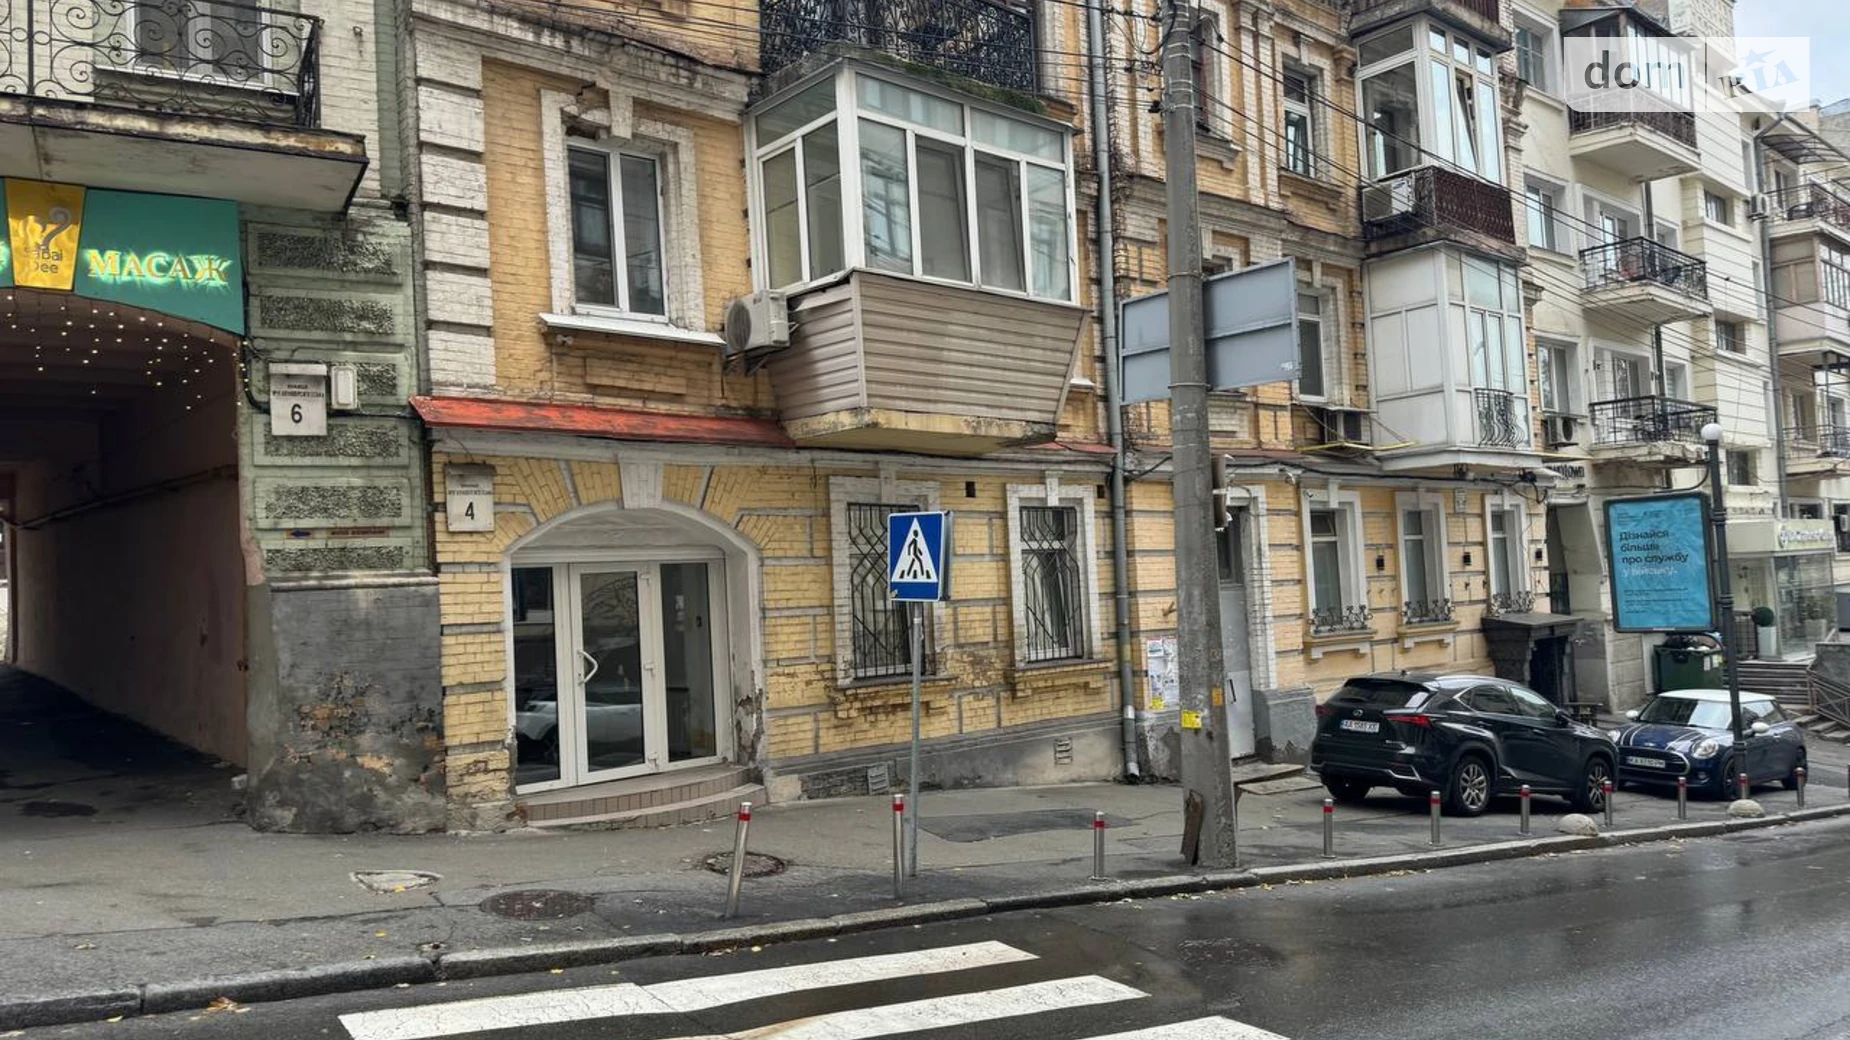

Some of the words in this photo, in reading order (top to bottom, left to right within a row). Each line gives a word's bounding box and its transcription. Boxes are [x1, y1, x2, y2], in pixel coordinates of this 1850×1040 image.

[87, 250, 231, 284] МАСАЖ
[291, 403, 303, 424] 6
[465, 501, 475, 520] 4
[1621, 556, 1643, 566] про
[1644, 552, 1689, 565] службу
